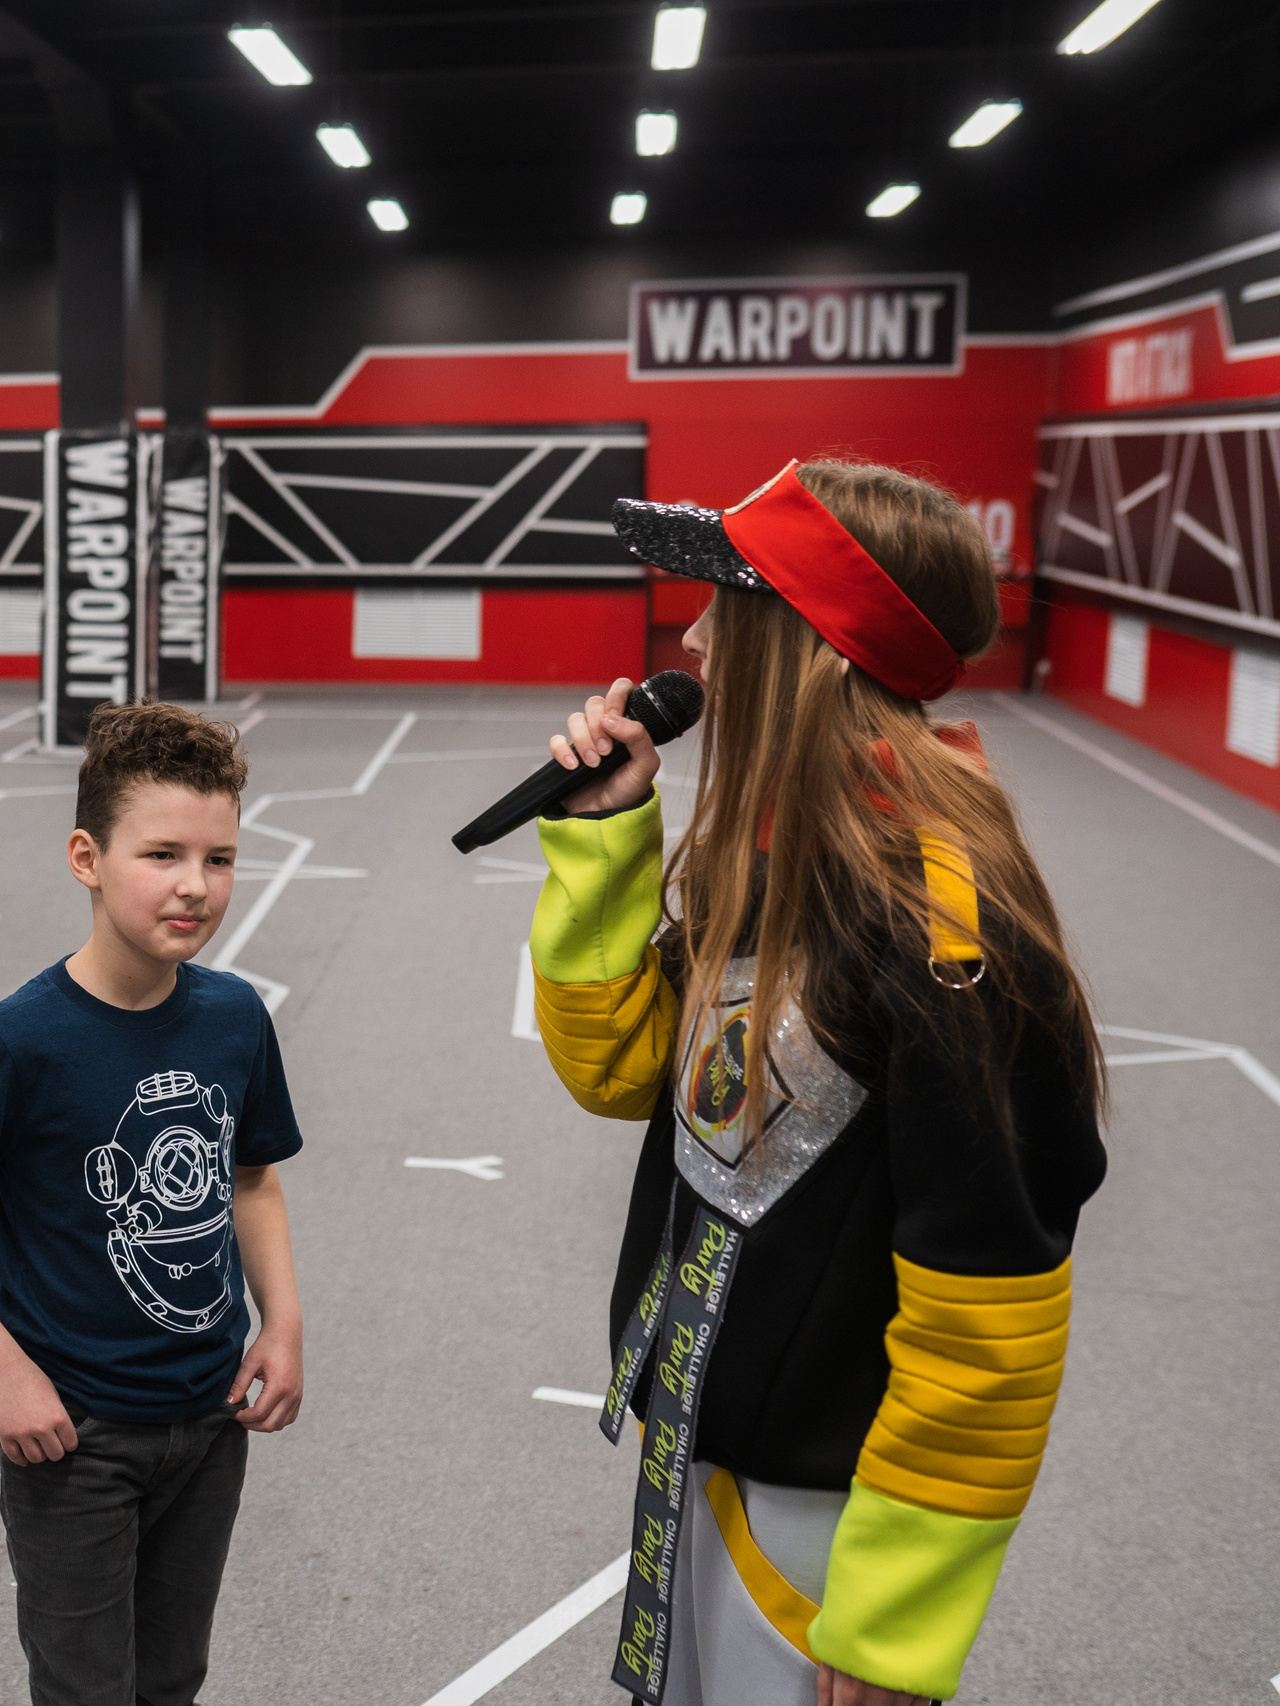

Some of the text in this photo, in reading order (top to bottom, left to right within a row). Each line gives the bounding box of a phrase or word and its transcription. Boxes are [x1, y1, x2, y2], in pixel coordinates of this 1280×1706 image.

[648, 294, 943, 362] WARPOINT
[65, 438, 130, 705] WARPOINT
[160, 476, 207, 664] WARPOINT
[680, 1221, 726, 1300] Party
[705, 1228, 739, 1315] HALLENGE
[659, 1321, 694, 1401] Party
[643, 1418, 677, 1498] Party
[634, 1513, 664, 1590] Party
[621, 1604, 655, 1682] Party
